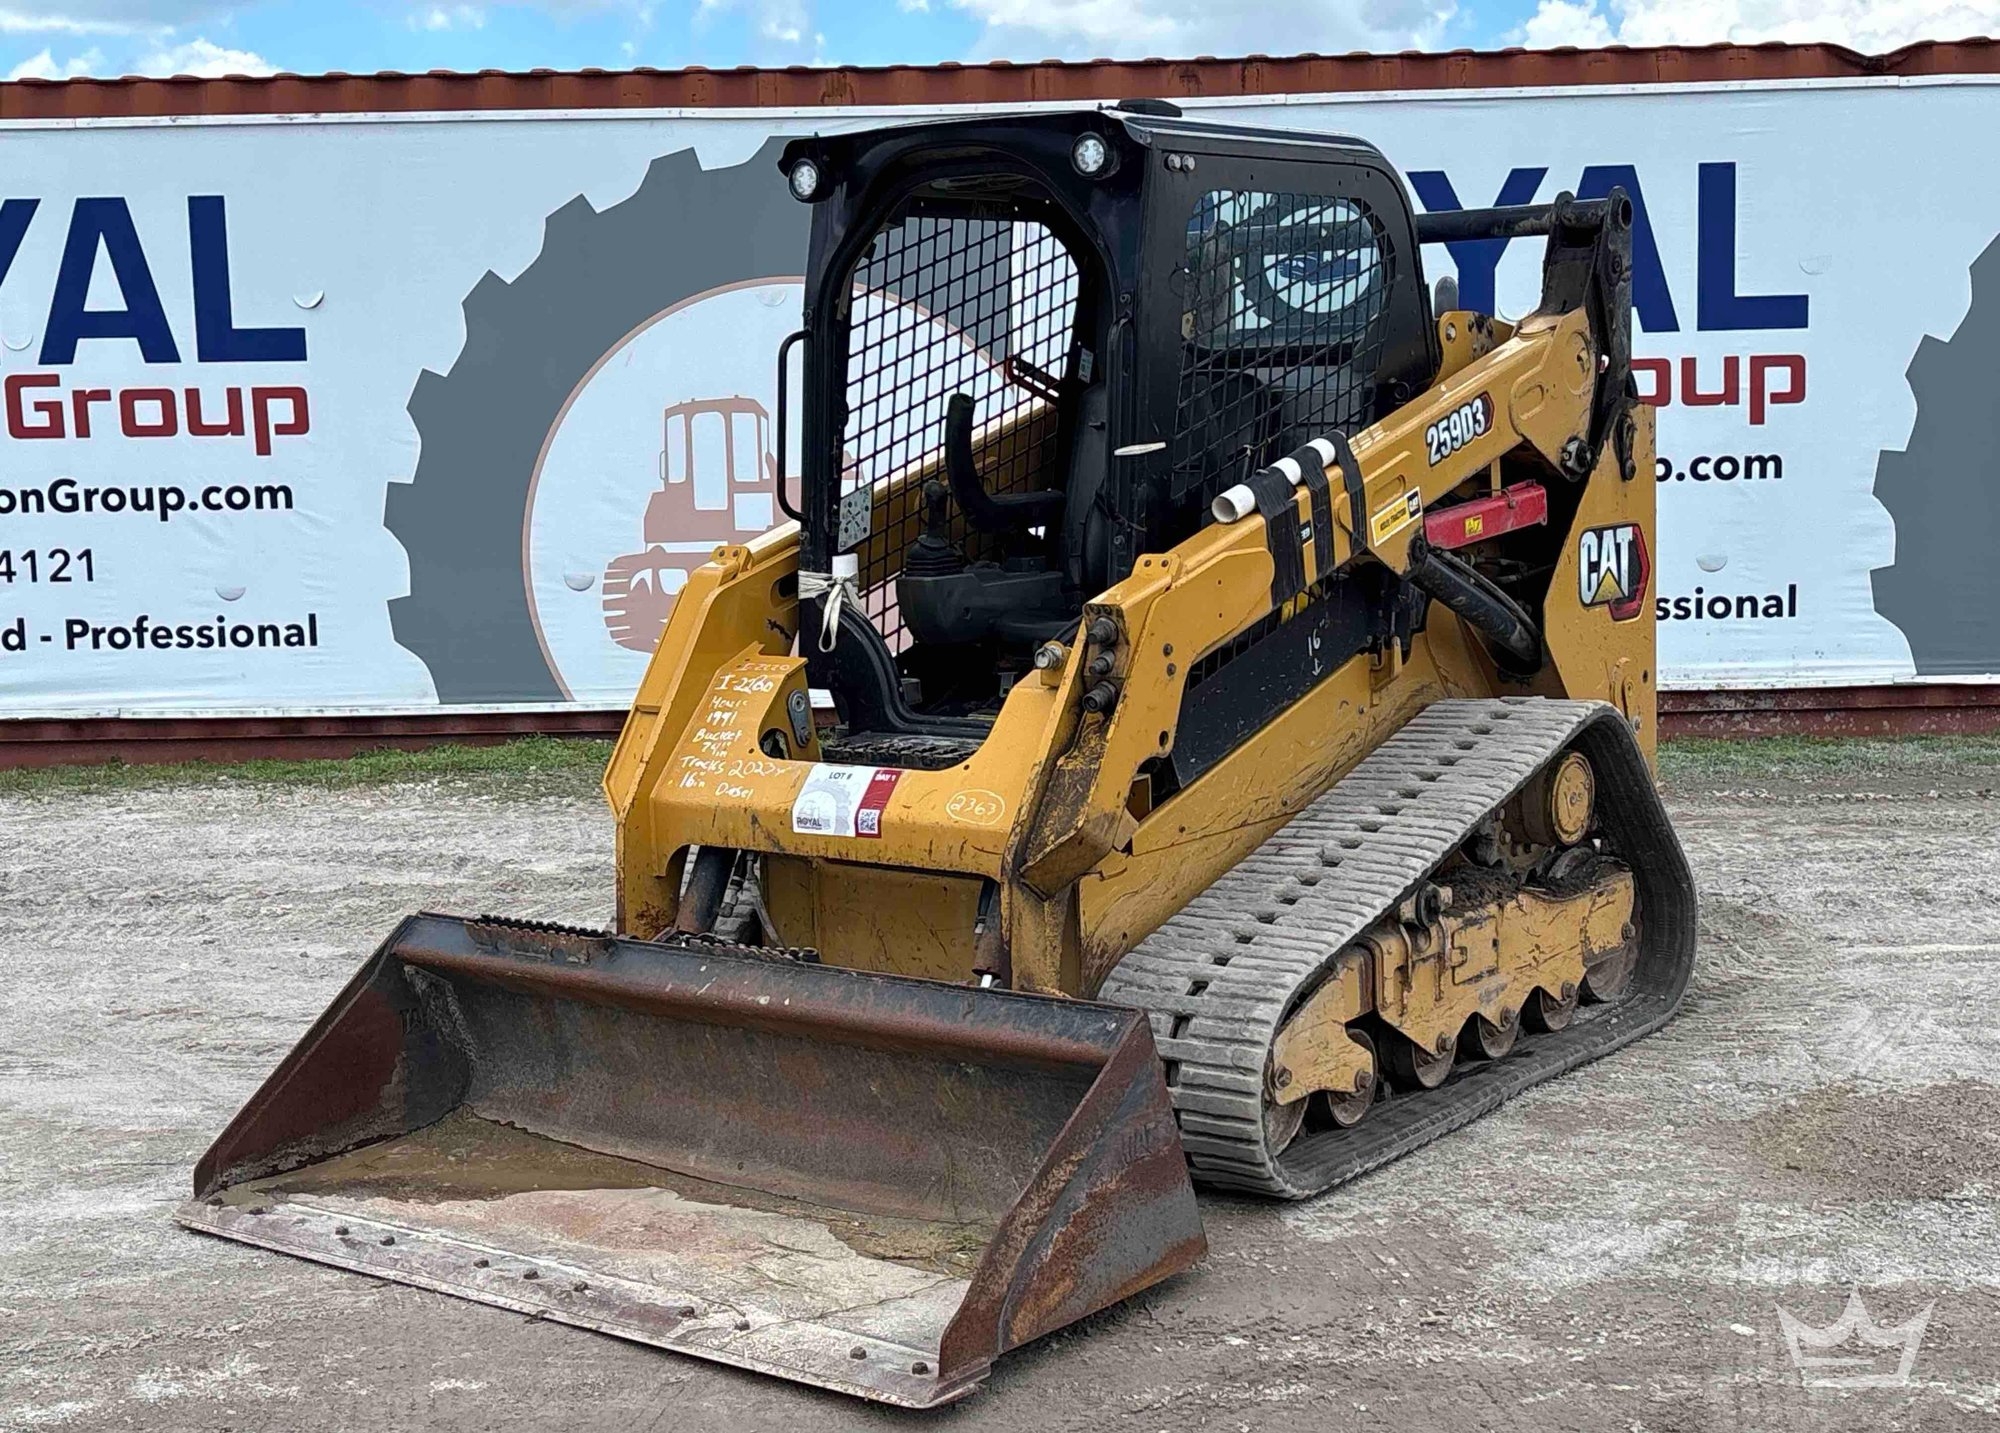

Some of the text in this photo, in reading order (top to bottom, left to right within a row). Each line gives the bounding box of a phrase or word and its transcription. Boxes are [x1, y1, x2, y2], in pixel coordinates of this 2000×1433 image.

[5, 374, 309, 456] Group
[1426, 397, 1486, 466] 259D3
[1579, 526, 1633, 605] CAT
[65, 613, 318, 650] Professional
[828, 772, 846, 780] LOT
[949, 795, 997, 816] 2363
